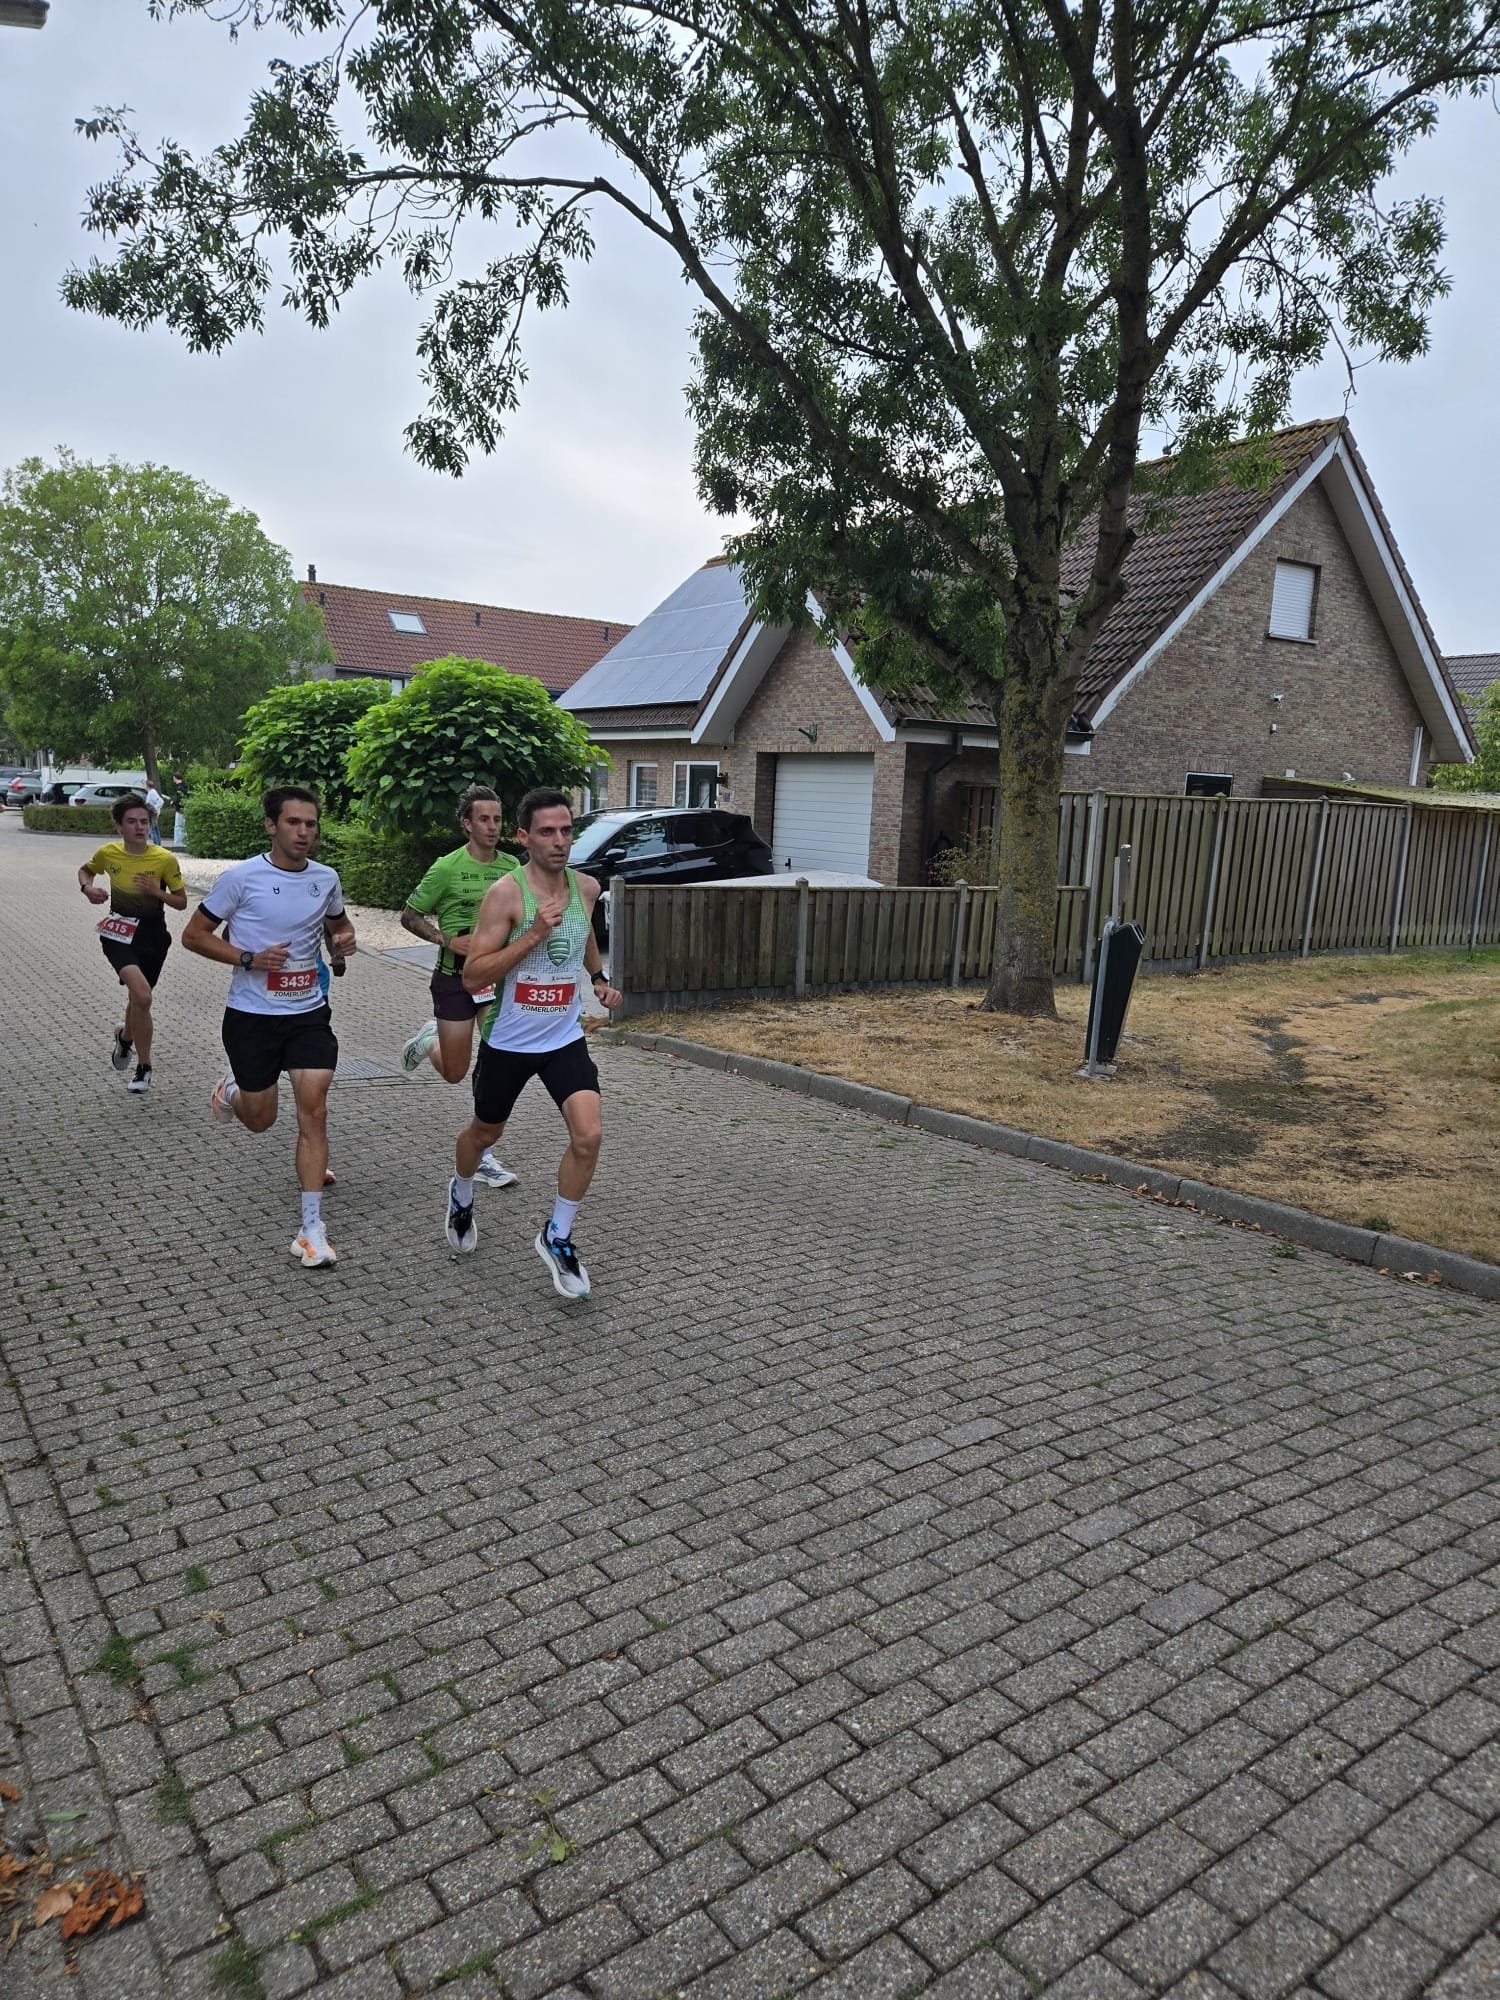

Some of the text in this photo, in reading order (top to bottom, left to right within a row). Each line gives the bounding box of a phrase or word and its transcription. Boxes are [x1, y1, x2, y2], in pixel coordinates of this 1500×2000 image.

[279, 974, 311, 988] 3432
[273, 989, 312, 998] ZOMERLOPEN
[527, 988, 564, 1003] 3351
[520, 1004, 568, 1013] ZOMERLOPEN
